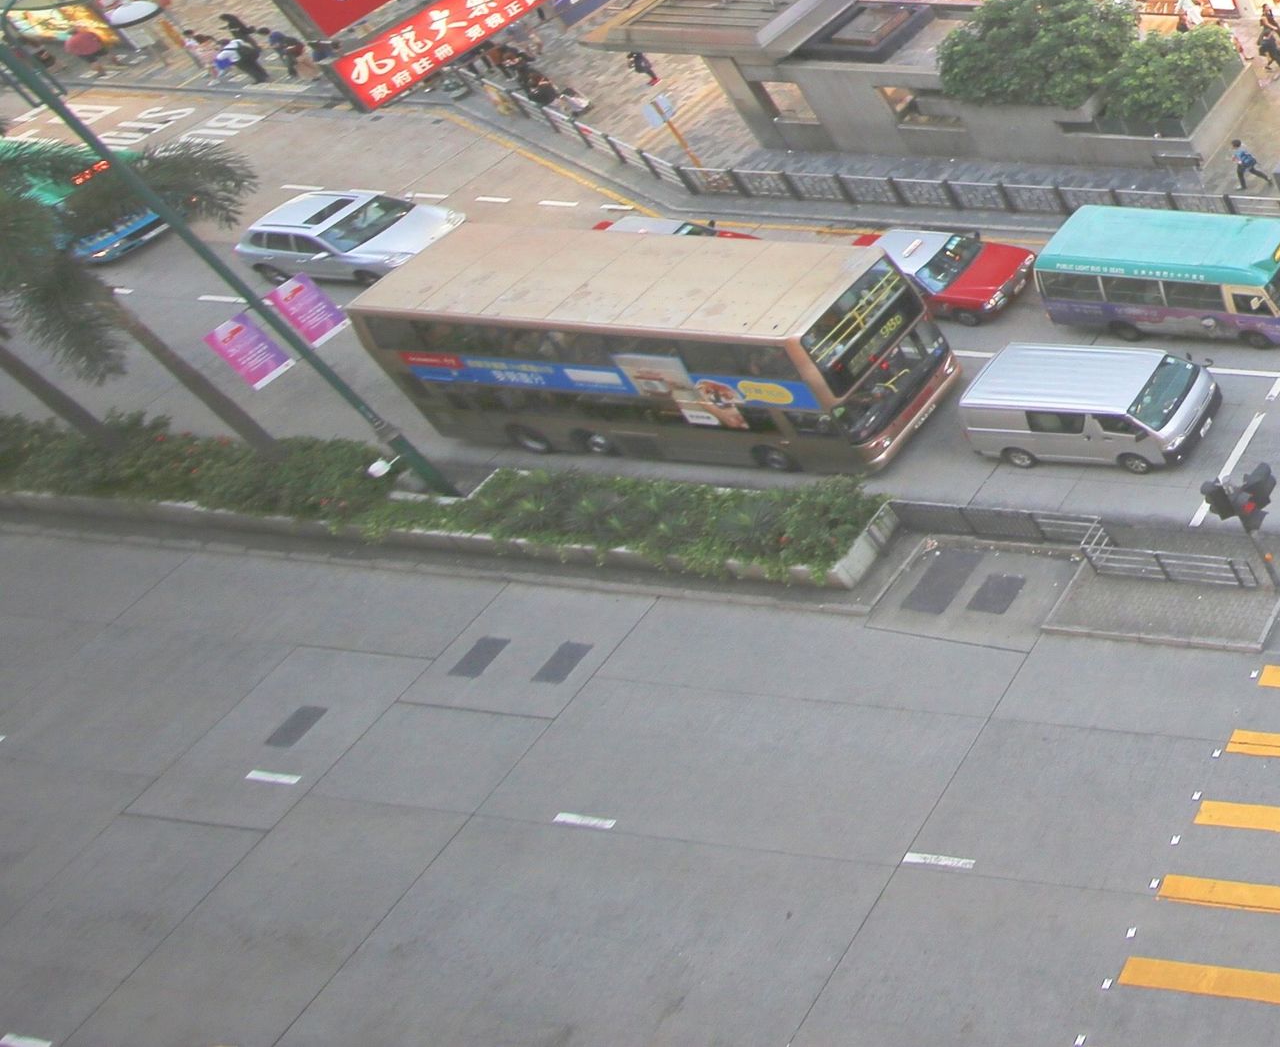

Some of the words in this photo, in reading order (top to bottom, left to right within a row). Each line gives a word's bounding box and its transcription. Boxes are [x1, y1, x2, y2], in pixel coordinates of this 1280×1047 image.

[1056, 263, 1074, 271] PUBLIC
[1075, 264, 1089, 272] LIGHT
[1109, 266, 1125, 274] SEATS
